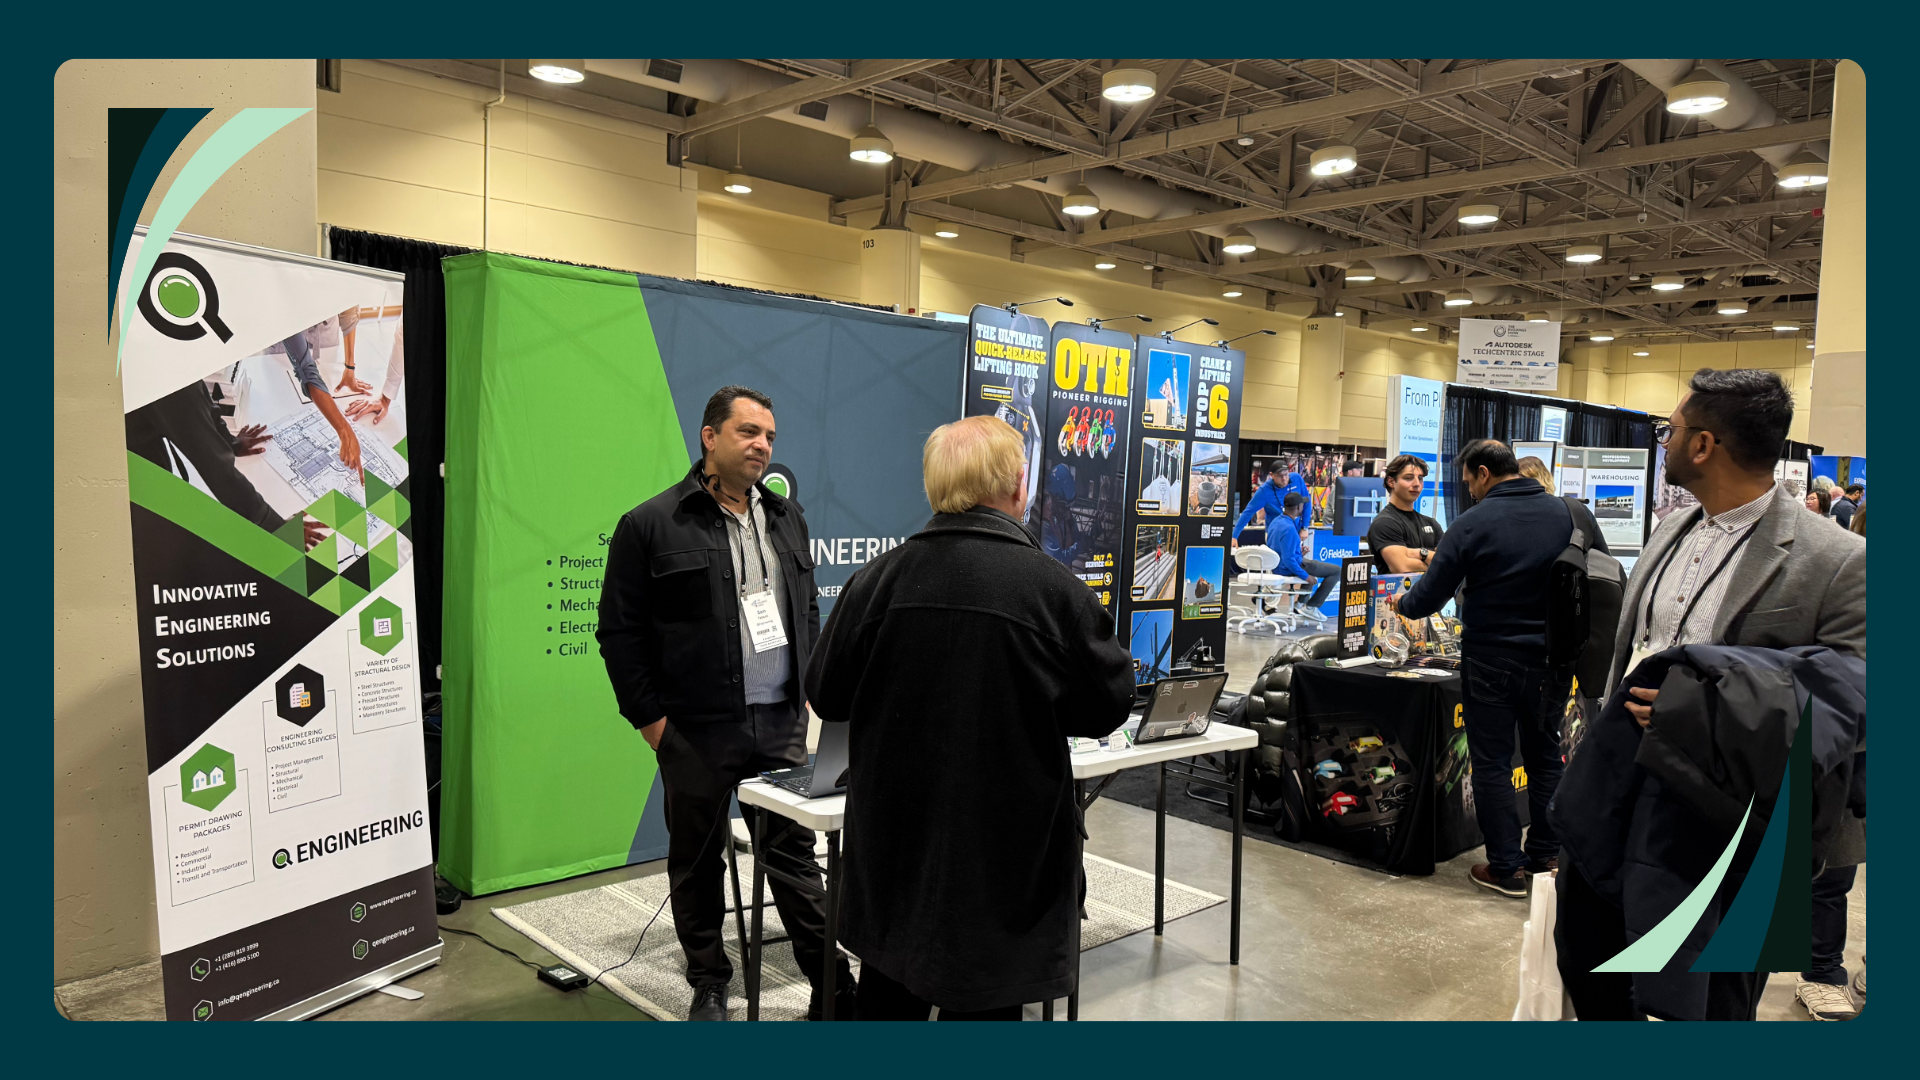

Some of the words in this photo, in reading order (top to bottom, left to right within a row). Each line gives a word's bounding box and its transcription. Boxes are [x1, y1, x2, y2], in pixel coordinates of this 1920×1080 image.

[863, 239, 875, 249] 103
[976, 322, 997, 341] THE
[998, 328, 1043, 349] ULTIMATE
[975, 340, 1047, 365] QUICK-RELEASE
[1473, 348, 1522, 357] TECHCENTRIC
[974, 356, 1013, 376] LIFTING
[1014, 362, 1039, 379] HOOK
[1054, 338, 1131, 398] OTH
[1200, 356, 1225, 370] CRANE
[1199, 369, 1231, 383] LIFTING
[1052, 390, 1090, 402] PIONEER
[1093, 395, 1128, 407] RIGGING
[1405, 387, 1430, 406] From
[1195, 381, 1209, 427] TOP
[1208, 384, 1230, 429] 6
[1404, 417, 1416, 425] Send
[1416, 419, 1428, 427] Price
[1195, 429, 1226, 439] INDUSTRIES
[1328, 549, 1353, 558] FieldApp
[559, 555, 604, 571] Project
[1347, 563, 1368, 582] OTH
[153, 582, 258, 605] INNOVATIVE
[1346, 590, 1367, 607] LEGO
[1345, 604, 1367, 617] CRANE
[155, 611, 271, 637] ENGINEERING
[1344, 616, 1366, 628] RAFFLE
[156, 642, 256, 669] SOLUTIONS
[558, 641, 588, 656] Civil
[354, 667, 391, 677] STRACTURAL
[391, 663, 411, 671] DESIGN
[366, 659, 390, 667] VARIETY
[372, 680, 395, 688] Structures
[381, 686, 403, 694] Structures
[376, 701, 398, 709] Structures
[378, 693, 400, 702] Structures
[385, 706, 407, 715] Structures
[266, 739, 307, 753] CONSULTING
[307, 733, 337, 744] SERVICES
[280, 729, 323, 742] ENGINEERING
[275, 761, 293, 770] Project
[292, 755, 324, 766] Management
[275, 767, 299, 777] Structural
[276, 774, 304, 785] Mechanical
[276, 783, 299, 793] Electrical
[178, 820, 207, 833] PERMIT
[208, 810, 243, 825] DRAWING
[193, 823, 231, 839] PACKAGES
[296, 809, 424, 863] ENGINEERING
[180, 846, 210, 860] Residential
[180, 853, 212, 868] Commercial
[181, 863, 207, 876] Industrial
[181, 873, 200, 884] Transit
[200, 870, 211, 878] and
[211, 859, 248, 875] Transportation
[369, 889, 417, 910] www.qengineering.ca
[371, 925, 415, 948] qengineering.ca
[221, 950, 236, 961] (289)
[222, 959, 236, 970] (416)
[246, 951, 260, 961] 5100
[217, 978, 280, 1008] info@qengineering.ca
